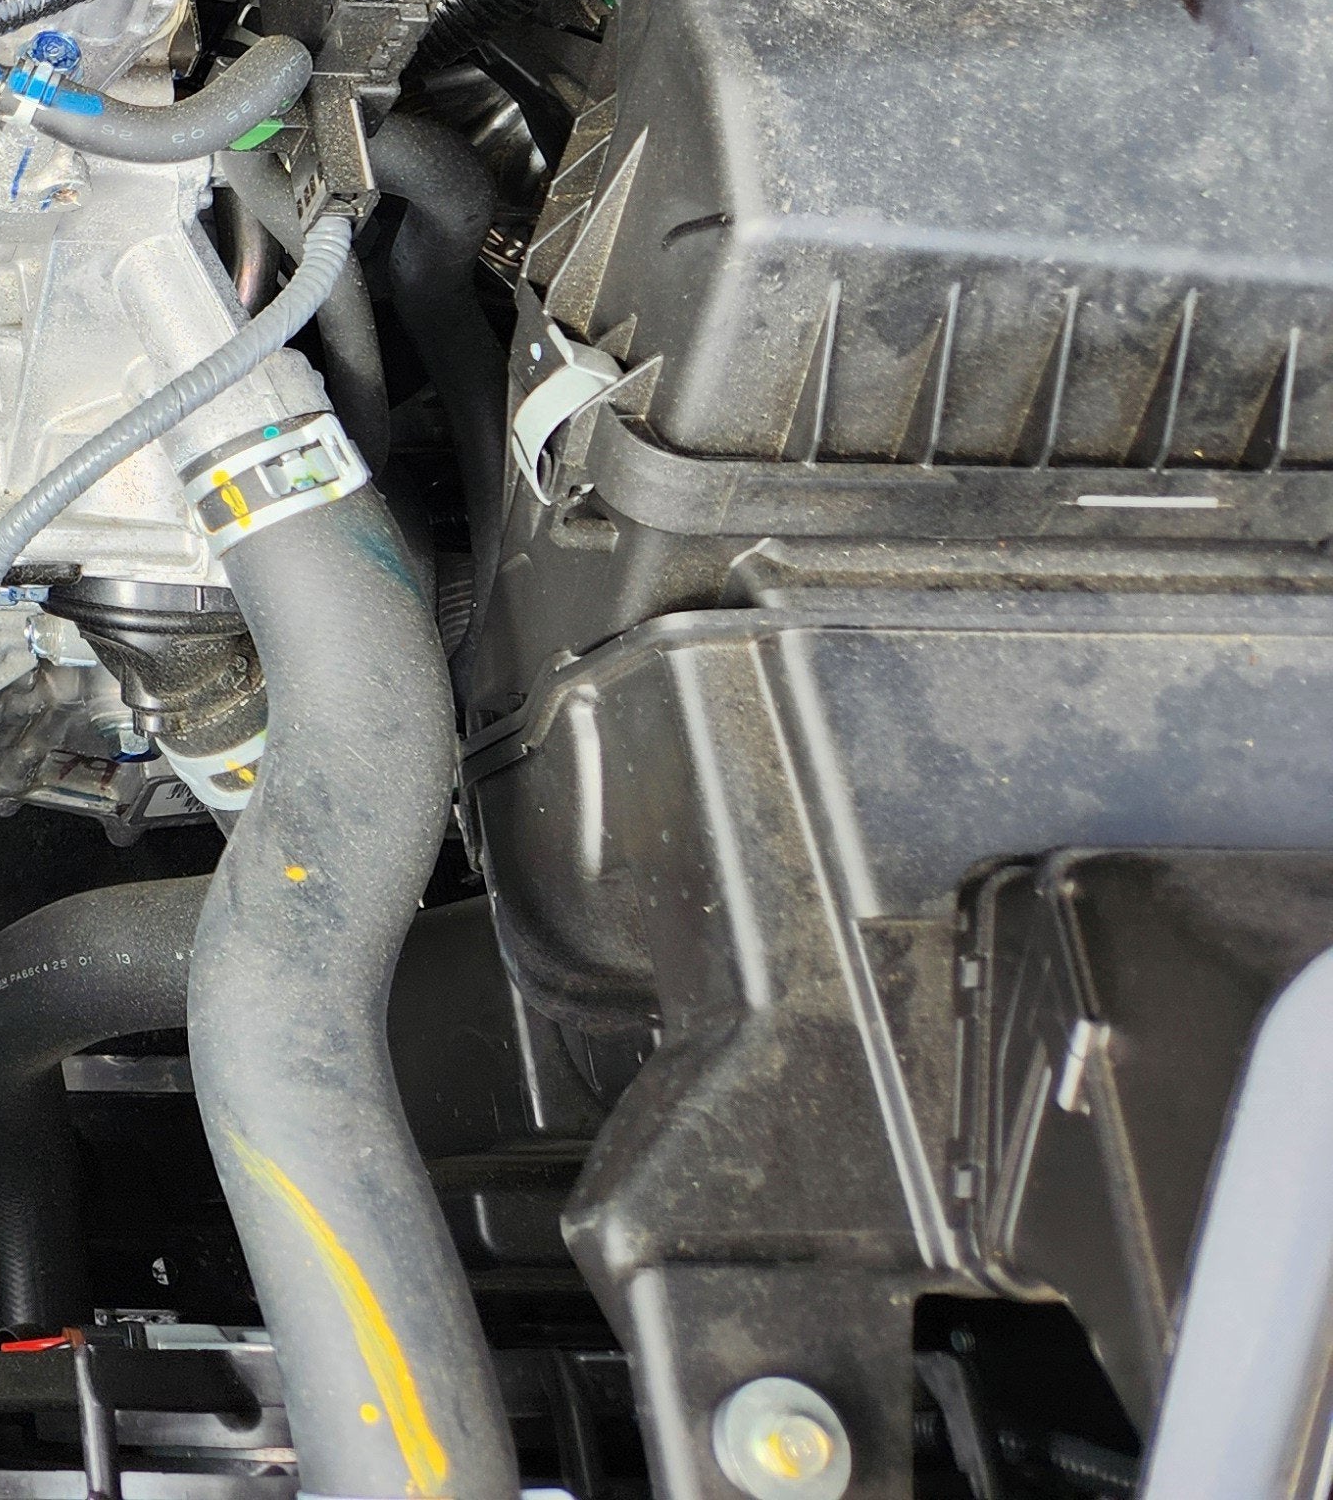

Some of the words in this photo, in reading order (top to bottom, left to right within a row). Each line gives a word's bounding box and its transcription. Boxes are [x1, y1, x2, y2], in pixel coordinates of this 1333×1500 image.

[225, 99, 253, 124] 25
[171, 128, 205, 145] 03
[51, 959, 68, 971] 25
